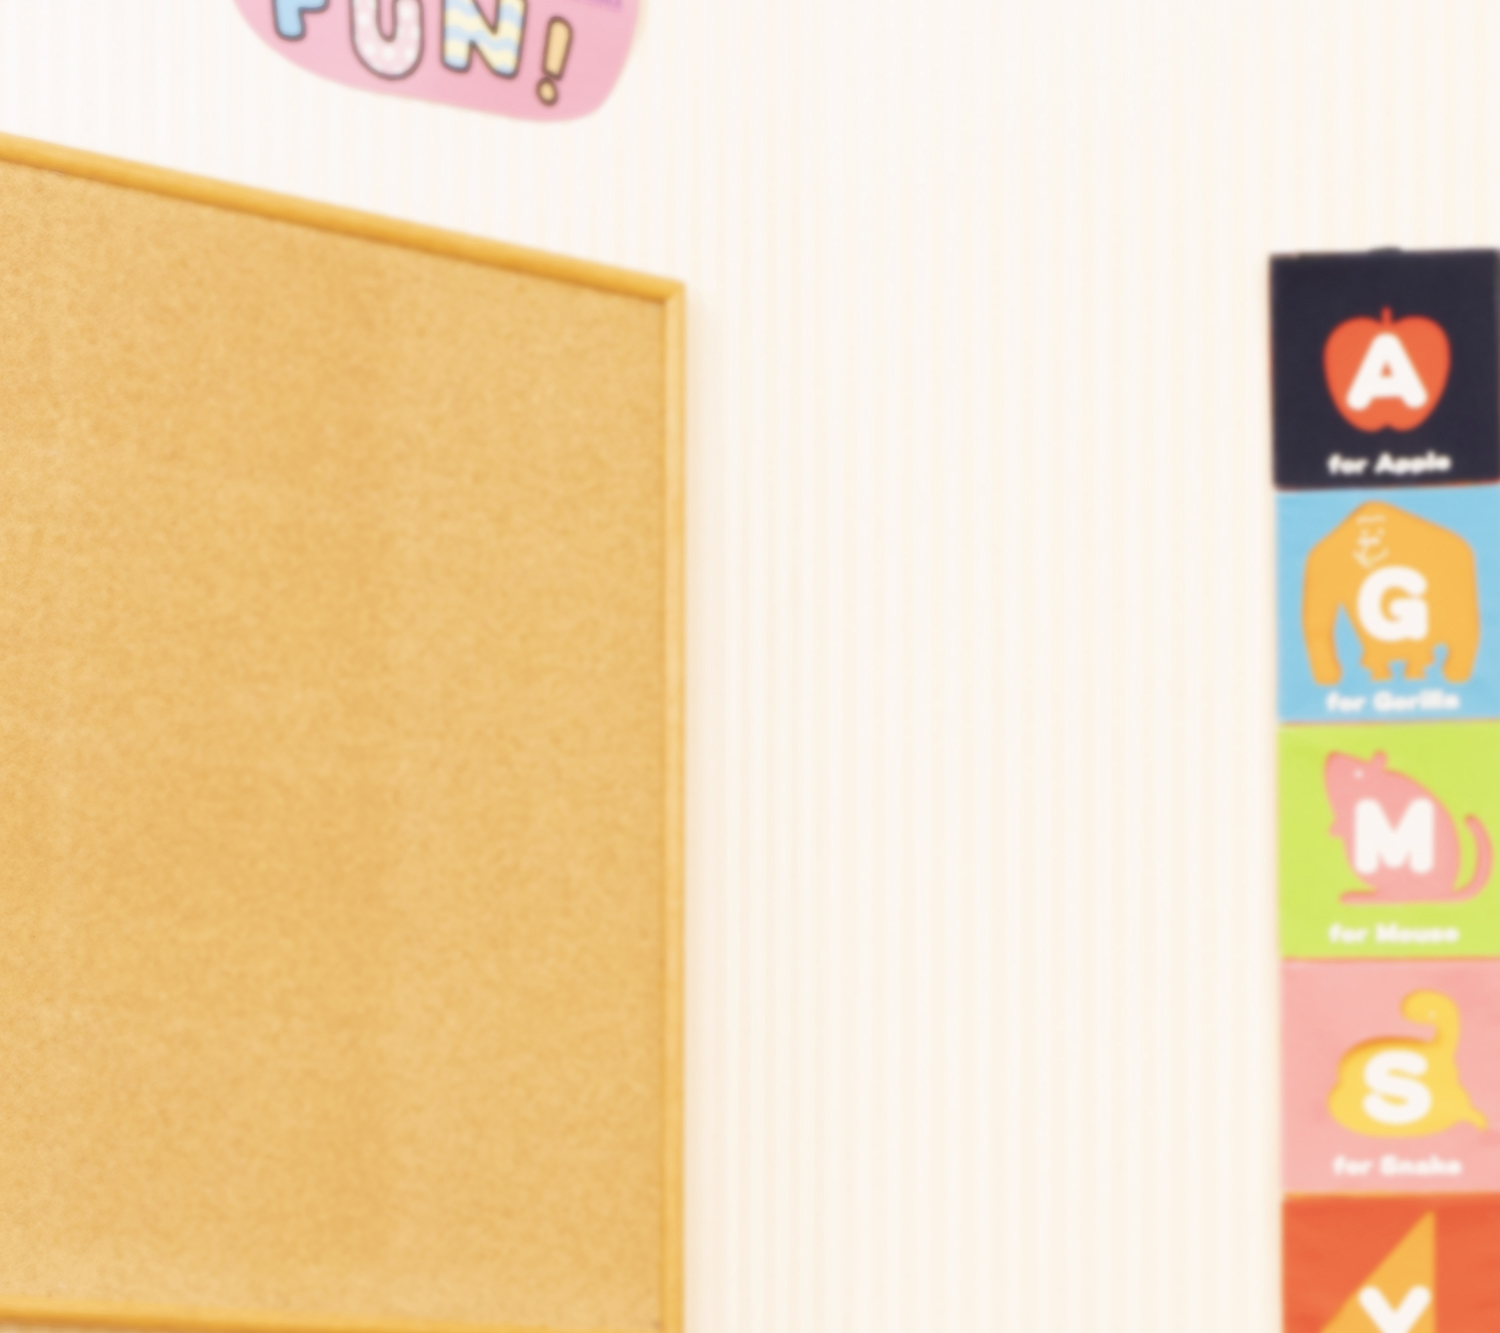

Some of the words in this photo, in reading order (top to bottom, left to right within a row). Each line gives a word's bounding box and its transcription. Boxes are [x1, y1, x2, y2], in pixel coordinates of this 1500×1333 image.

[1345, 333, 1428, 412] A
[1326, 454, 1369, 476] for
[1373, 452, 1452, 476] Apple
[1356, 566, 1430, 643] G
[1324, 691, 1368, 714] for
[1353, 798, 1435, 875] M
[1327, 923, 1370, 945] for
[1373, 923, 1461, 945] Mouse
[1361, 1050, 1433, 1126] S
[1331, 1155, 1374, 1177] for
[1378, 1154, 1463, 1177] Snake
